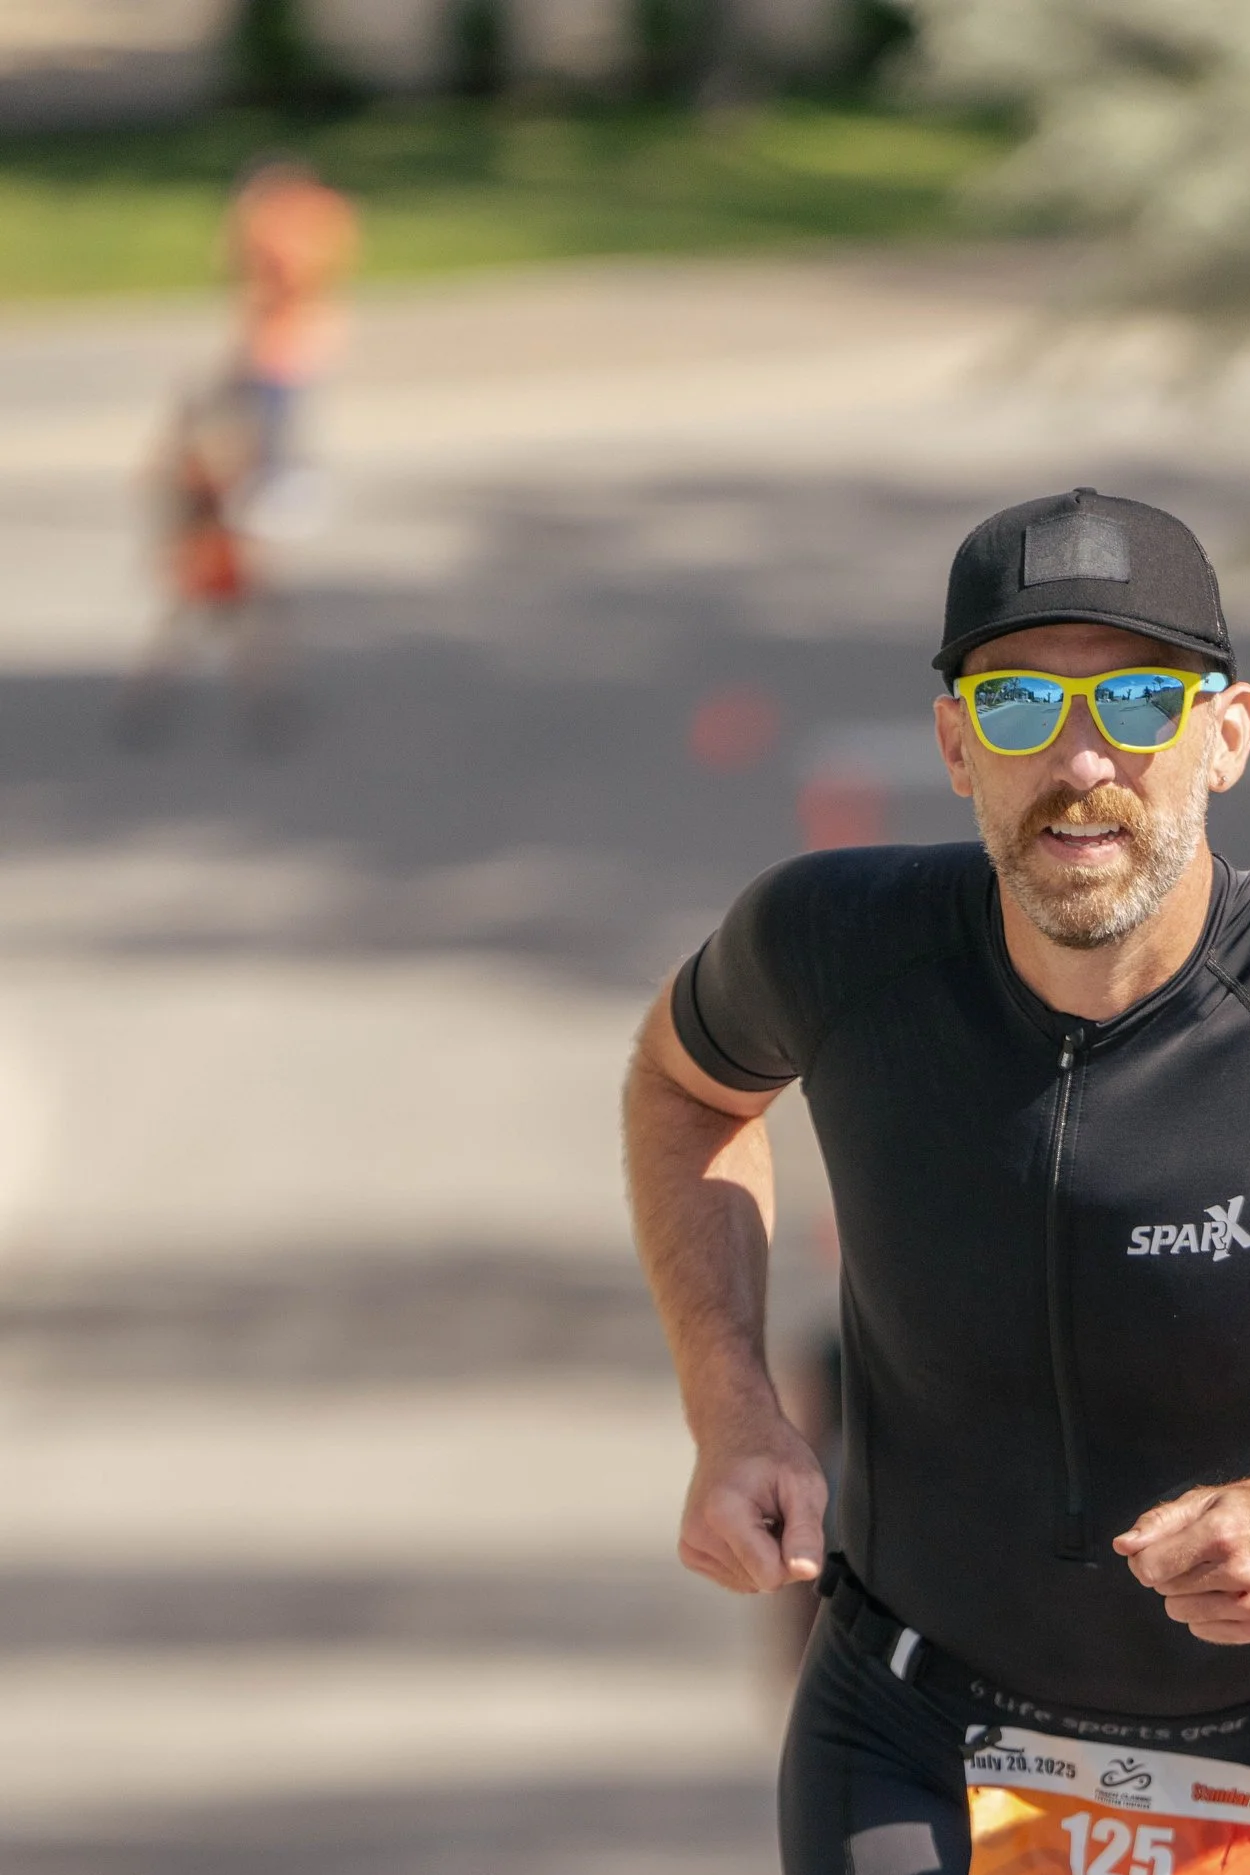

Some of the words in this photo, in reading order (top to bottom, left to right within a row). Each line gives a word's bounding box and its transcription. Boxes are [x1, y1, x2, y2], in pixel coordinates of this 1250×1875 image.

[1061, 1717, 1171, 1740] sports
[1180, 1715, 1248, 1742] gear
[1034, 1757, 1077, 1780] 2025
